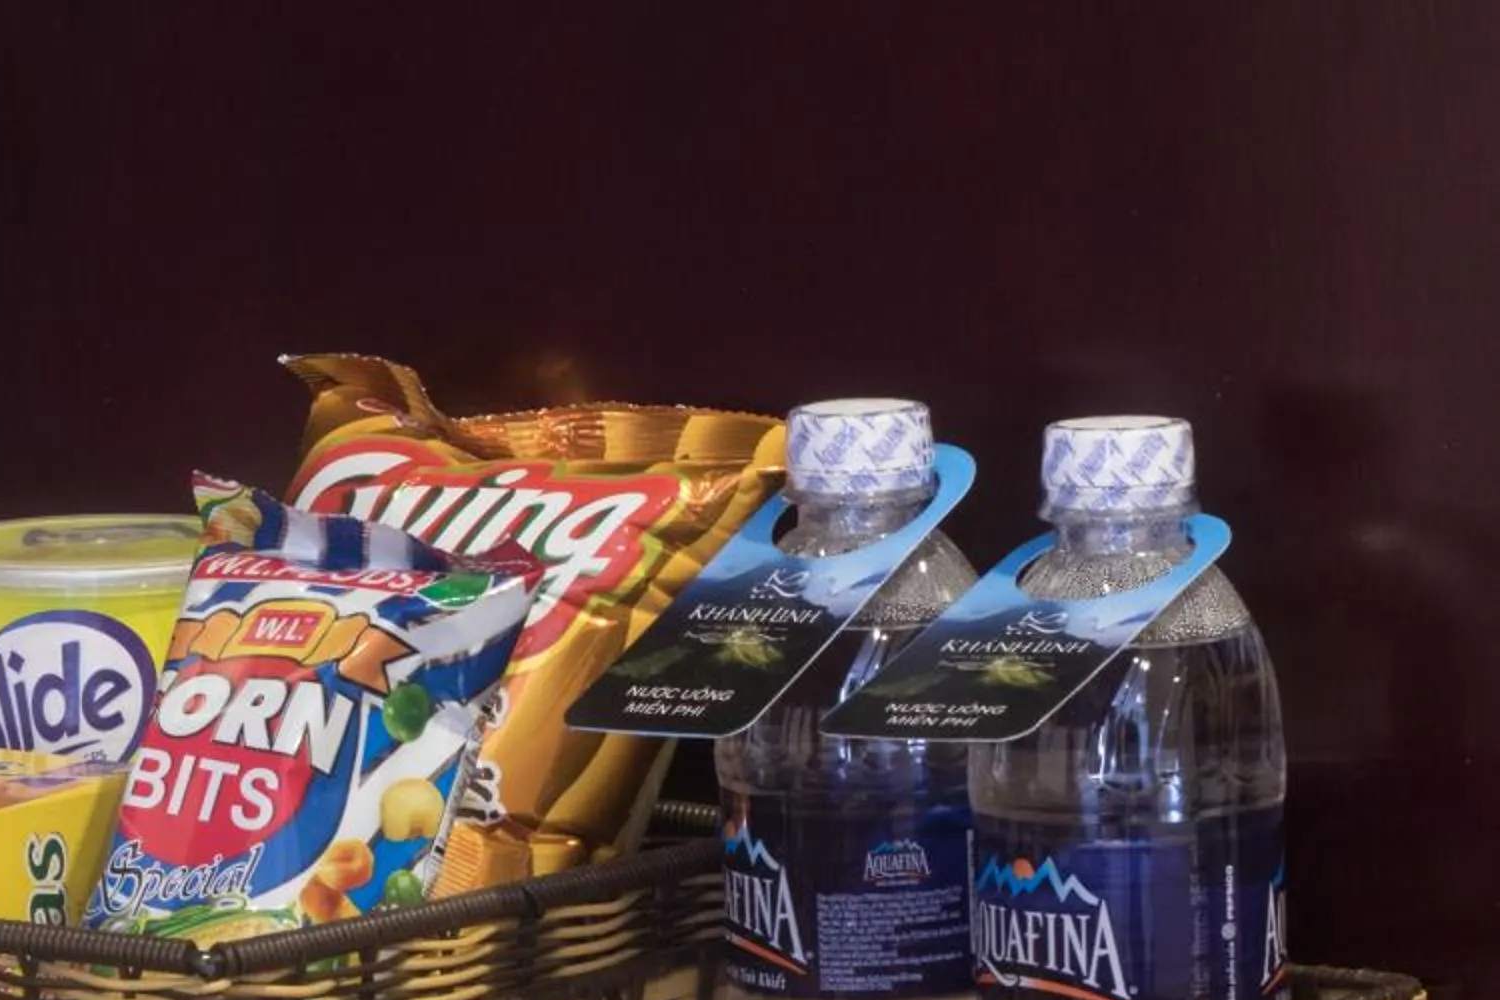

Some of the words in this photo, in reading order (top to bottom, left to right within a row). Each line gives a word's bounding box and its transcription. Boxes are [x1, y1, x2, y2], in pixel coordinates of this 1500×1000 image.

[157, 671, 355, 776] ORN
[122, 746, 280, 831] BITS
[96, 838, 265, 918] Special
[863, 851, 931, 881] AQUAFINA
